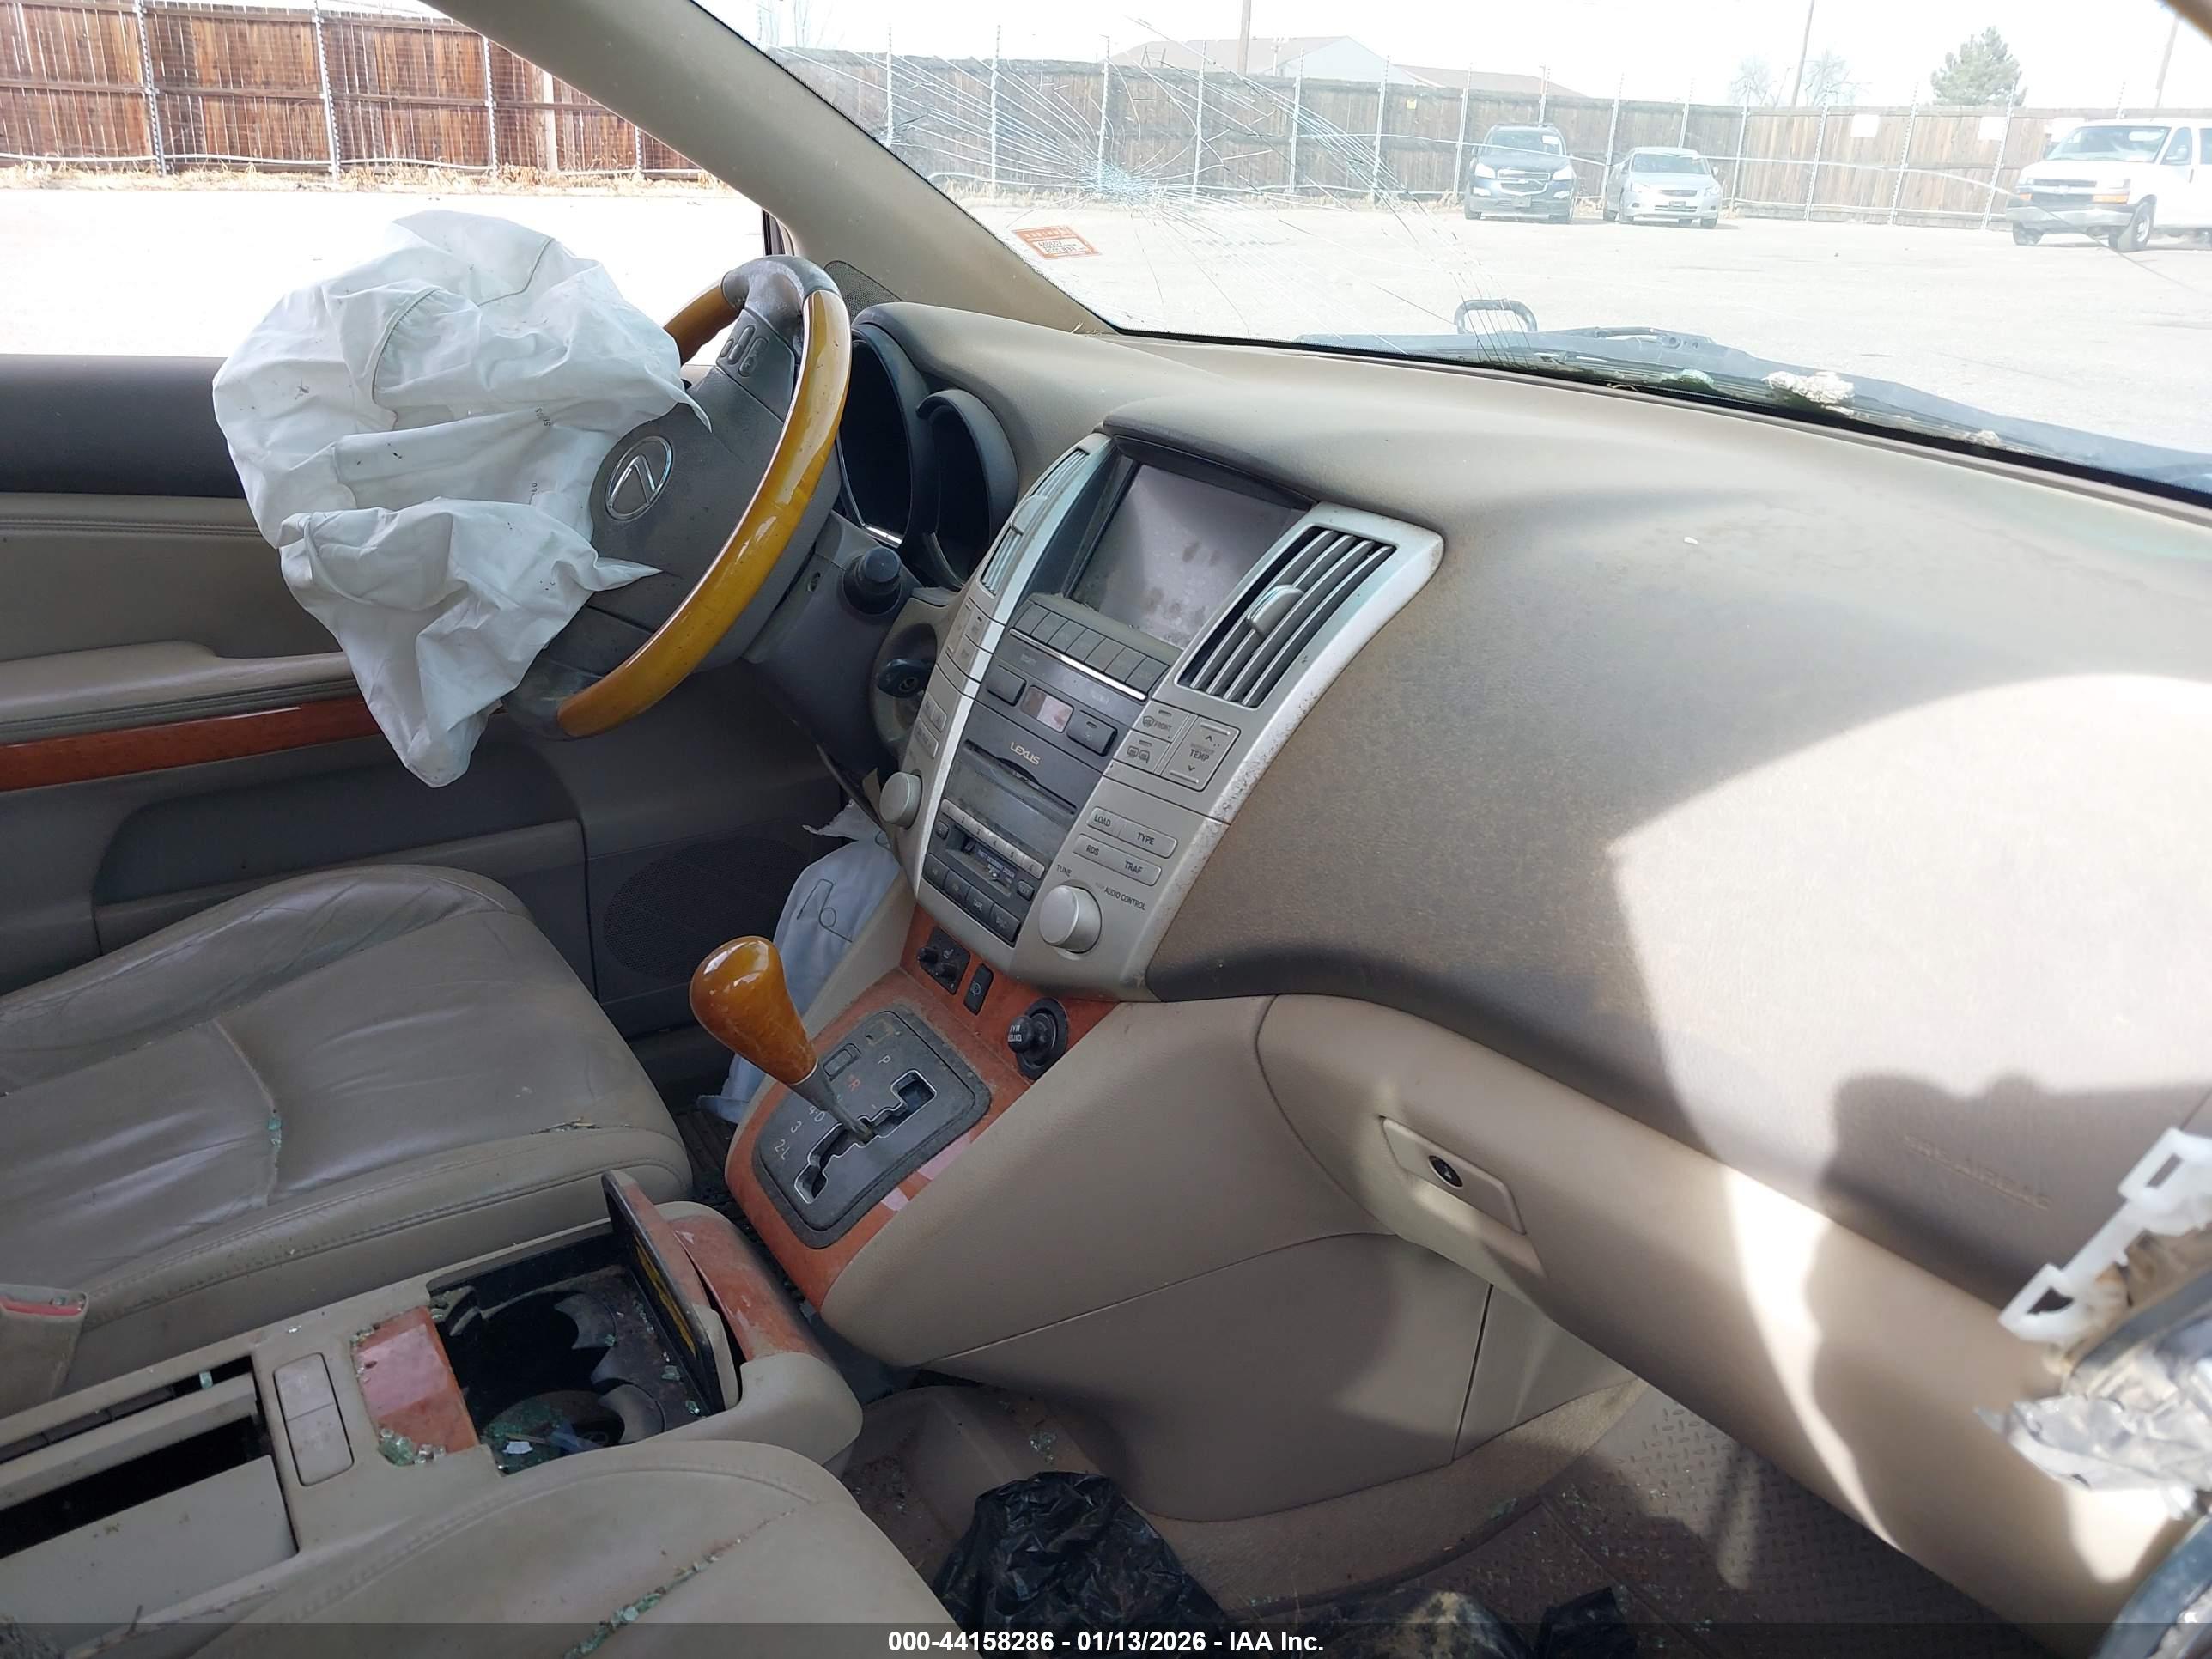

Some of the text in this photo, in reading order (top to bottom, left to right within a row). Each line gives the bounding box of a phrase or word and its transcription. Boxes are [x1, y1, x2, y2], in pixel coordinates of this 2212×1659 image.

[1010, 741, 1041, 765] LEXUS
[1189, 748, 1210, 763] TEMP
[1093, 813, 1111, 827] LOAD
[1136, 831, 1155, 846] TYPE
[1085, 844, 1100, 856] RDS
[1056, 864, 1073, 877] TUNE
[1124, 860, 1144, 874] TRAF
[1103, 885, 1121, 899] AUDIO
[1121, 892, 1146, 910] CONTROL
[878, 1054, 891, 1065] P
[848, 1079, 861, 1092] R
[790, 1120, 803, 1133] 3
